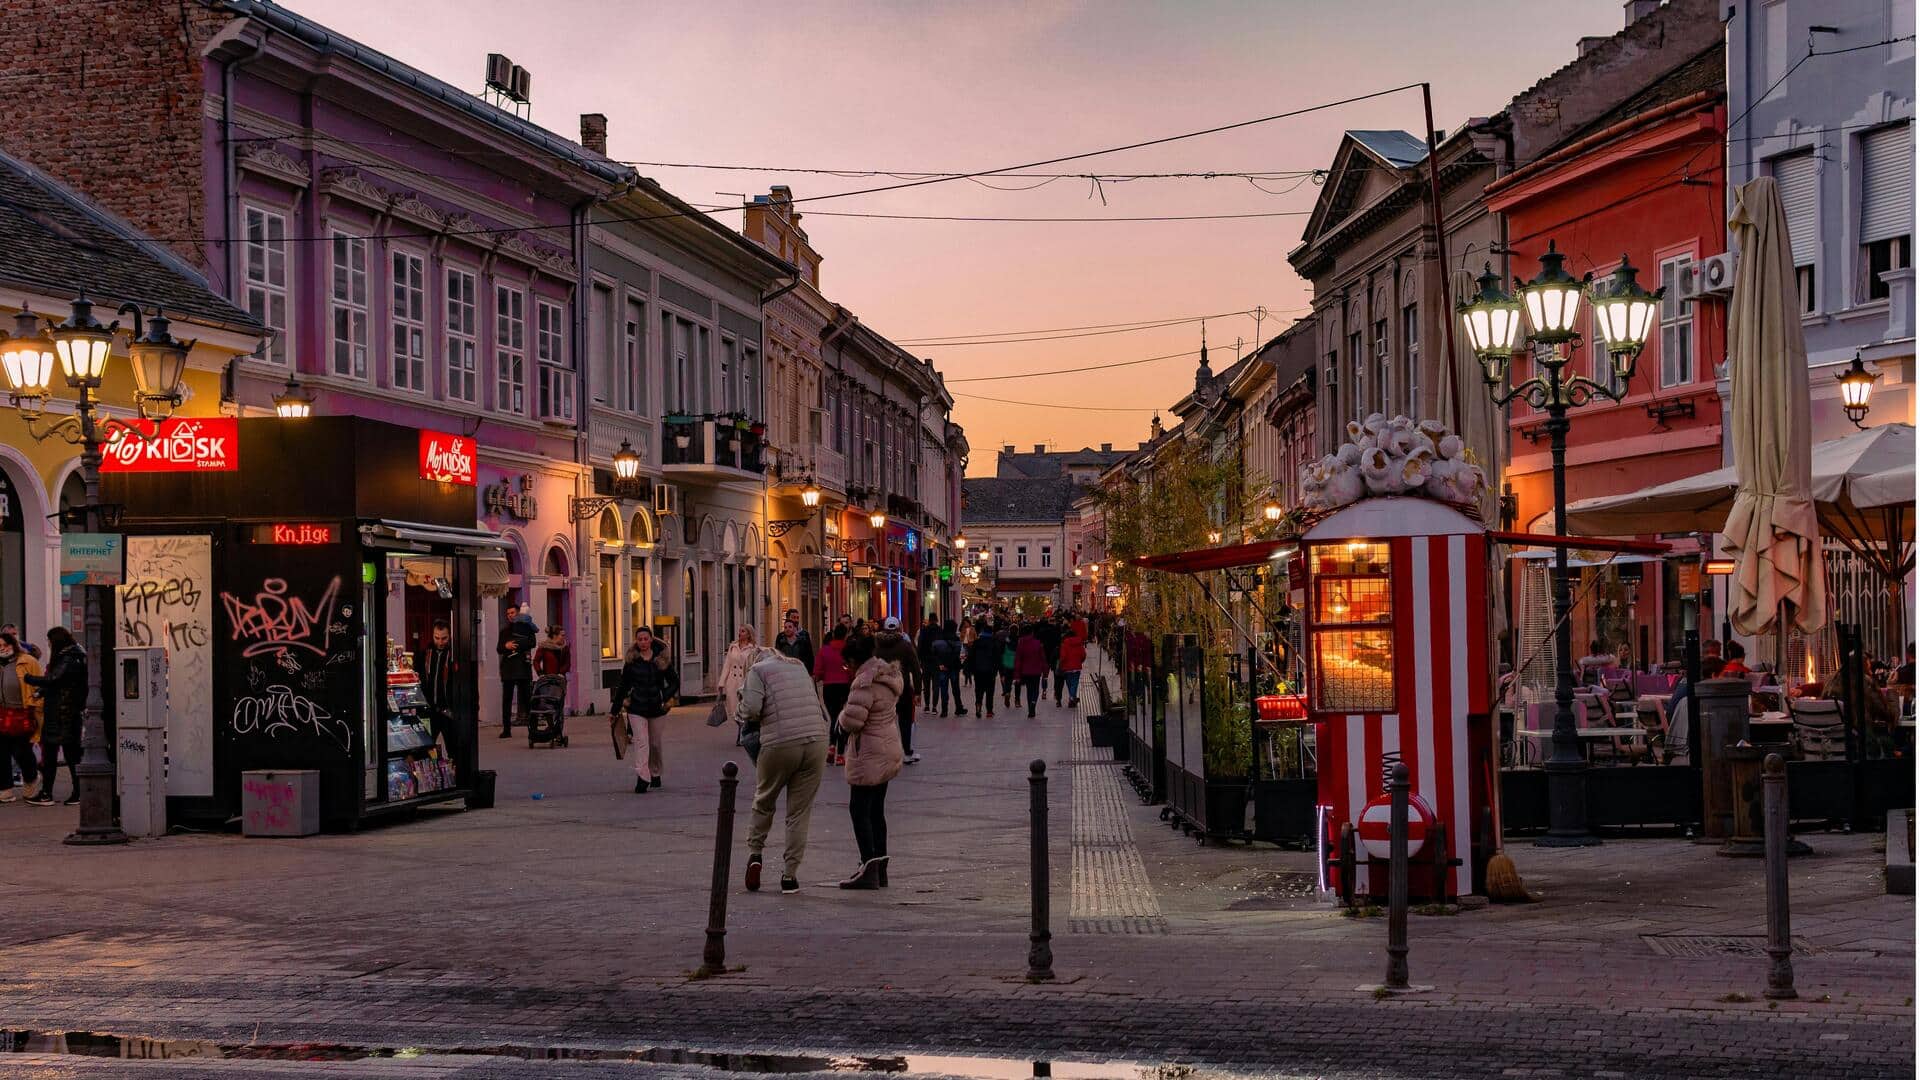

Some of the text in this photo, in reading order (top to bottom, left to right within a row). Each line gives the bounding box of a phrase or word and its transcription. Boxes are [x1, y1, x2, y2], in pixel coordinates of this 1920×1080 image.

[102, 428, 225, 465] Moj KIOSK
[426, 441, 442, 474] Moj
